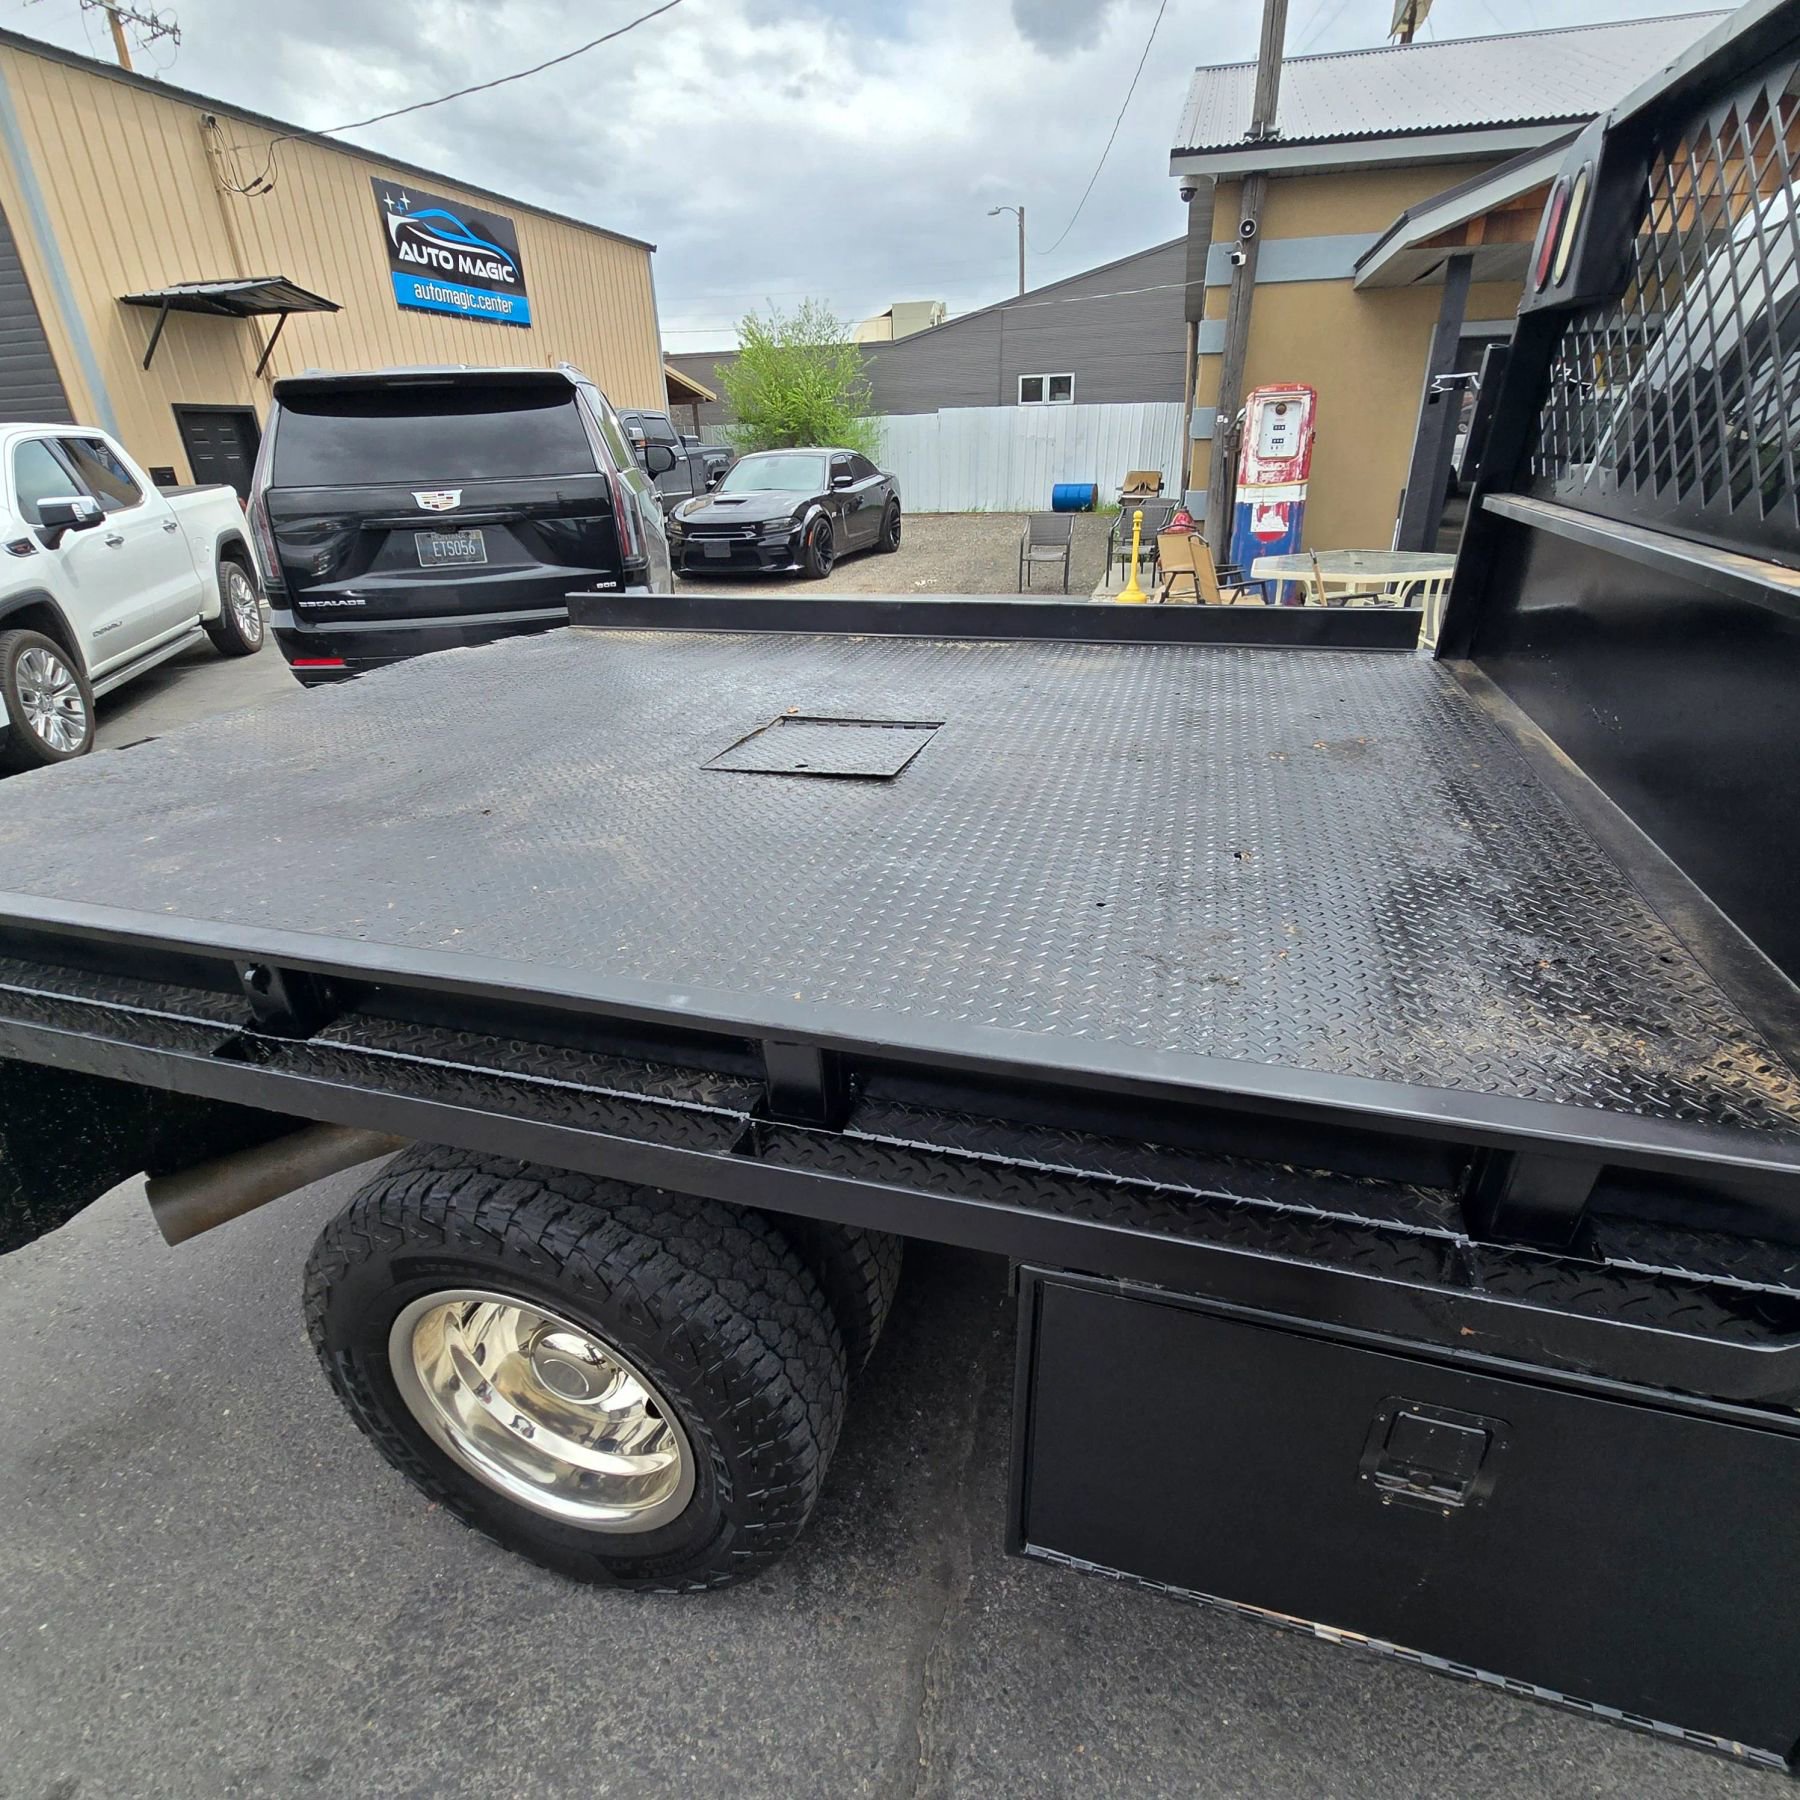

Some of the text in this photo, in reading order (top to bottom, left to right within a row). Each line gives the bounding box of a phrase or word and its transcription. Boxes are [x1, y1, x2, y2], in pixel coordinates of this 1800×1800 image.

[399, 241, 515, 283] AUTO MAGIC
[414, 282, 513, 313] automagic.center
[432, 540, 476, 557] ETS056
[298, 600, 367, 608] ESCALADE
